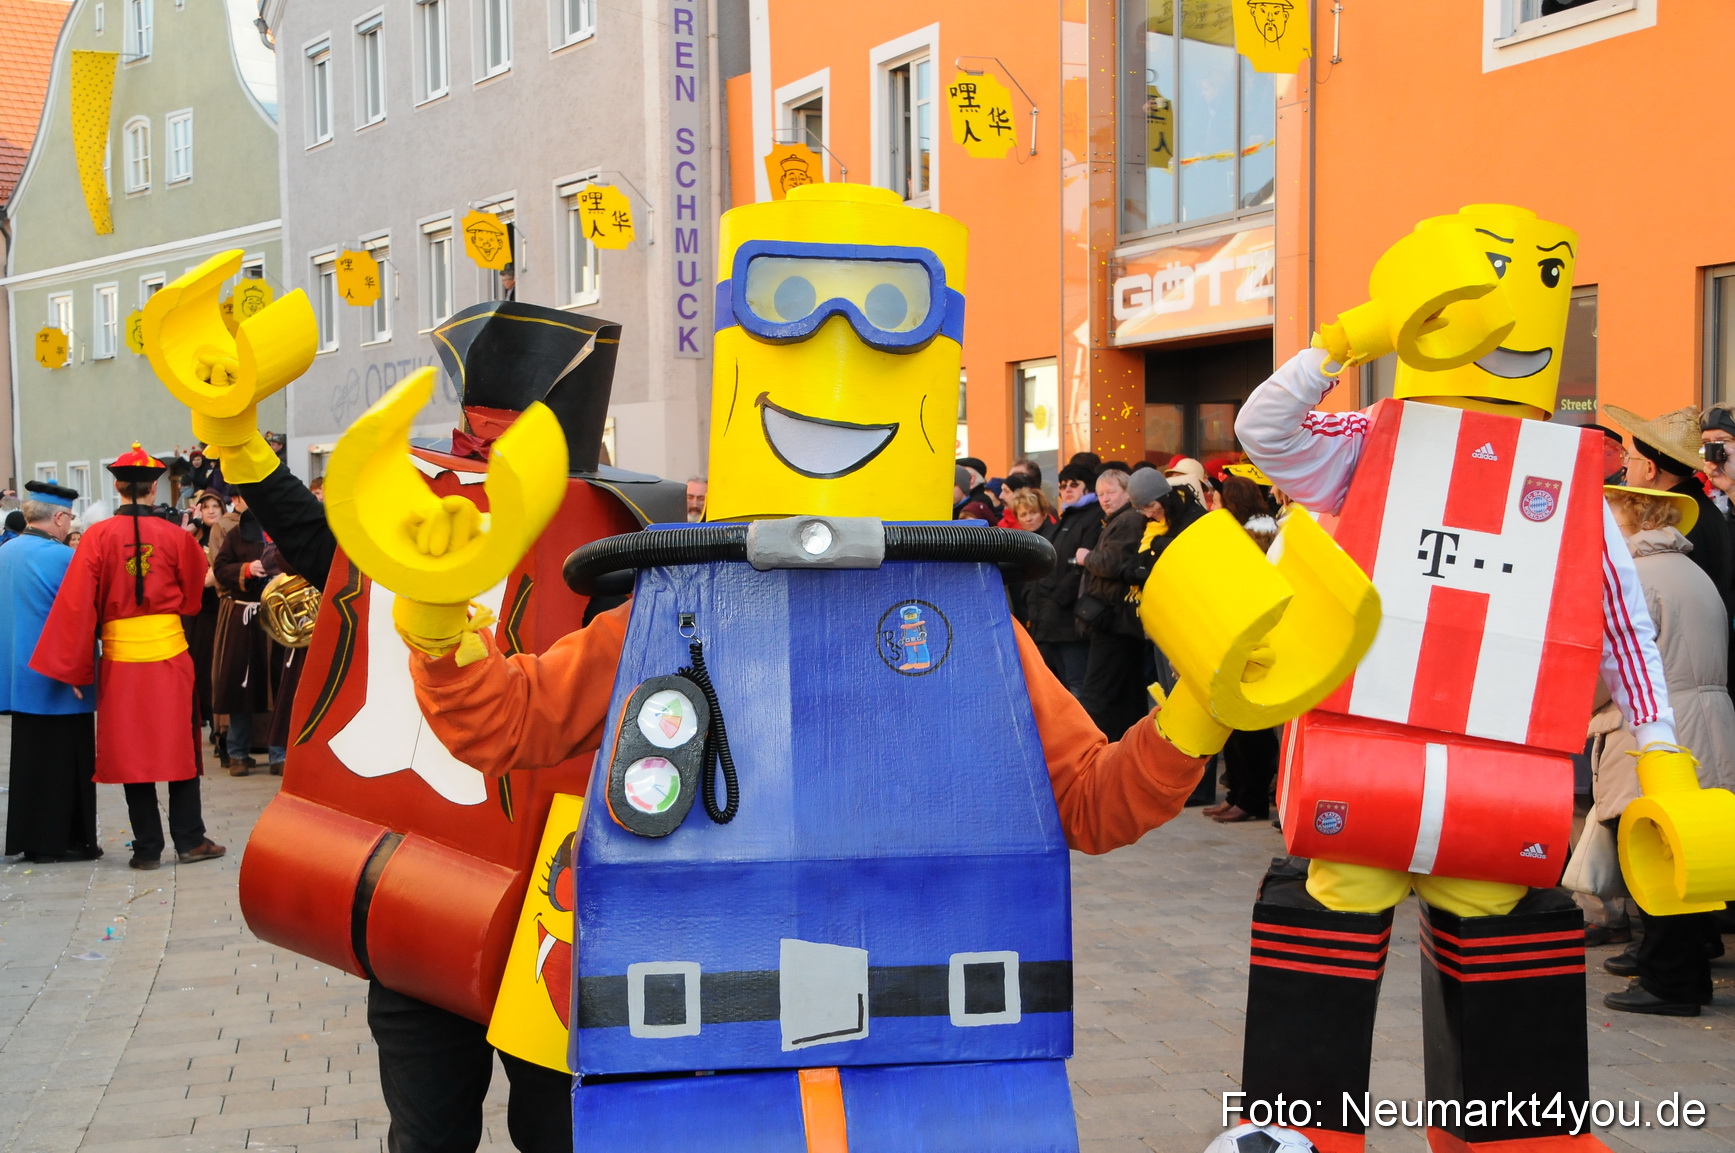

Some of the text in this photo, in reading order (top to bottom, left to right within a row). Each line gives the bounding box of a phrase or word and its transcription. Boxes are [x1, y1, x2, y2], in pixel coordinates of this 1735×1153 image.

[674, 0, 699, 353] REN SCHMUCK
[1113, 250, 1274, 321] GÖTZ
[1560, 398, 1592, 410] Street
[1471, 452, 1498, 461] adidas
